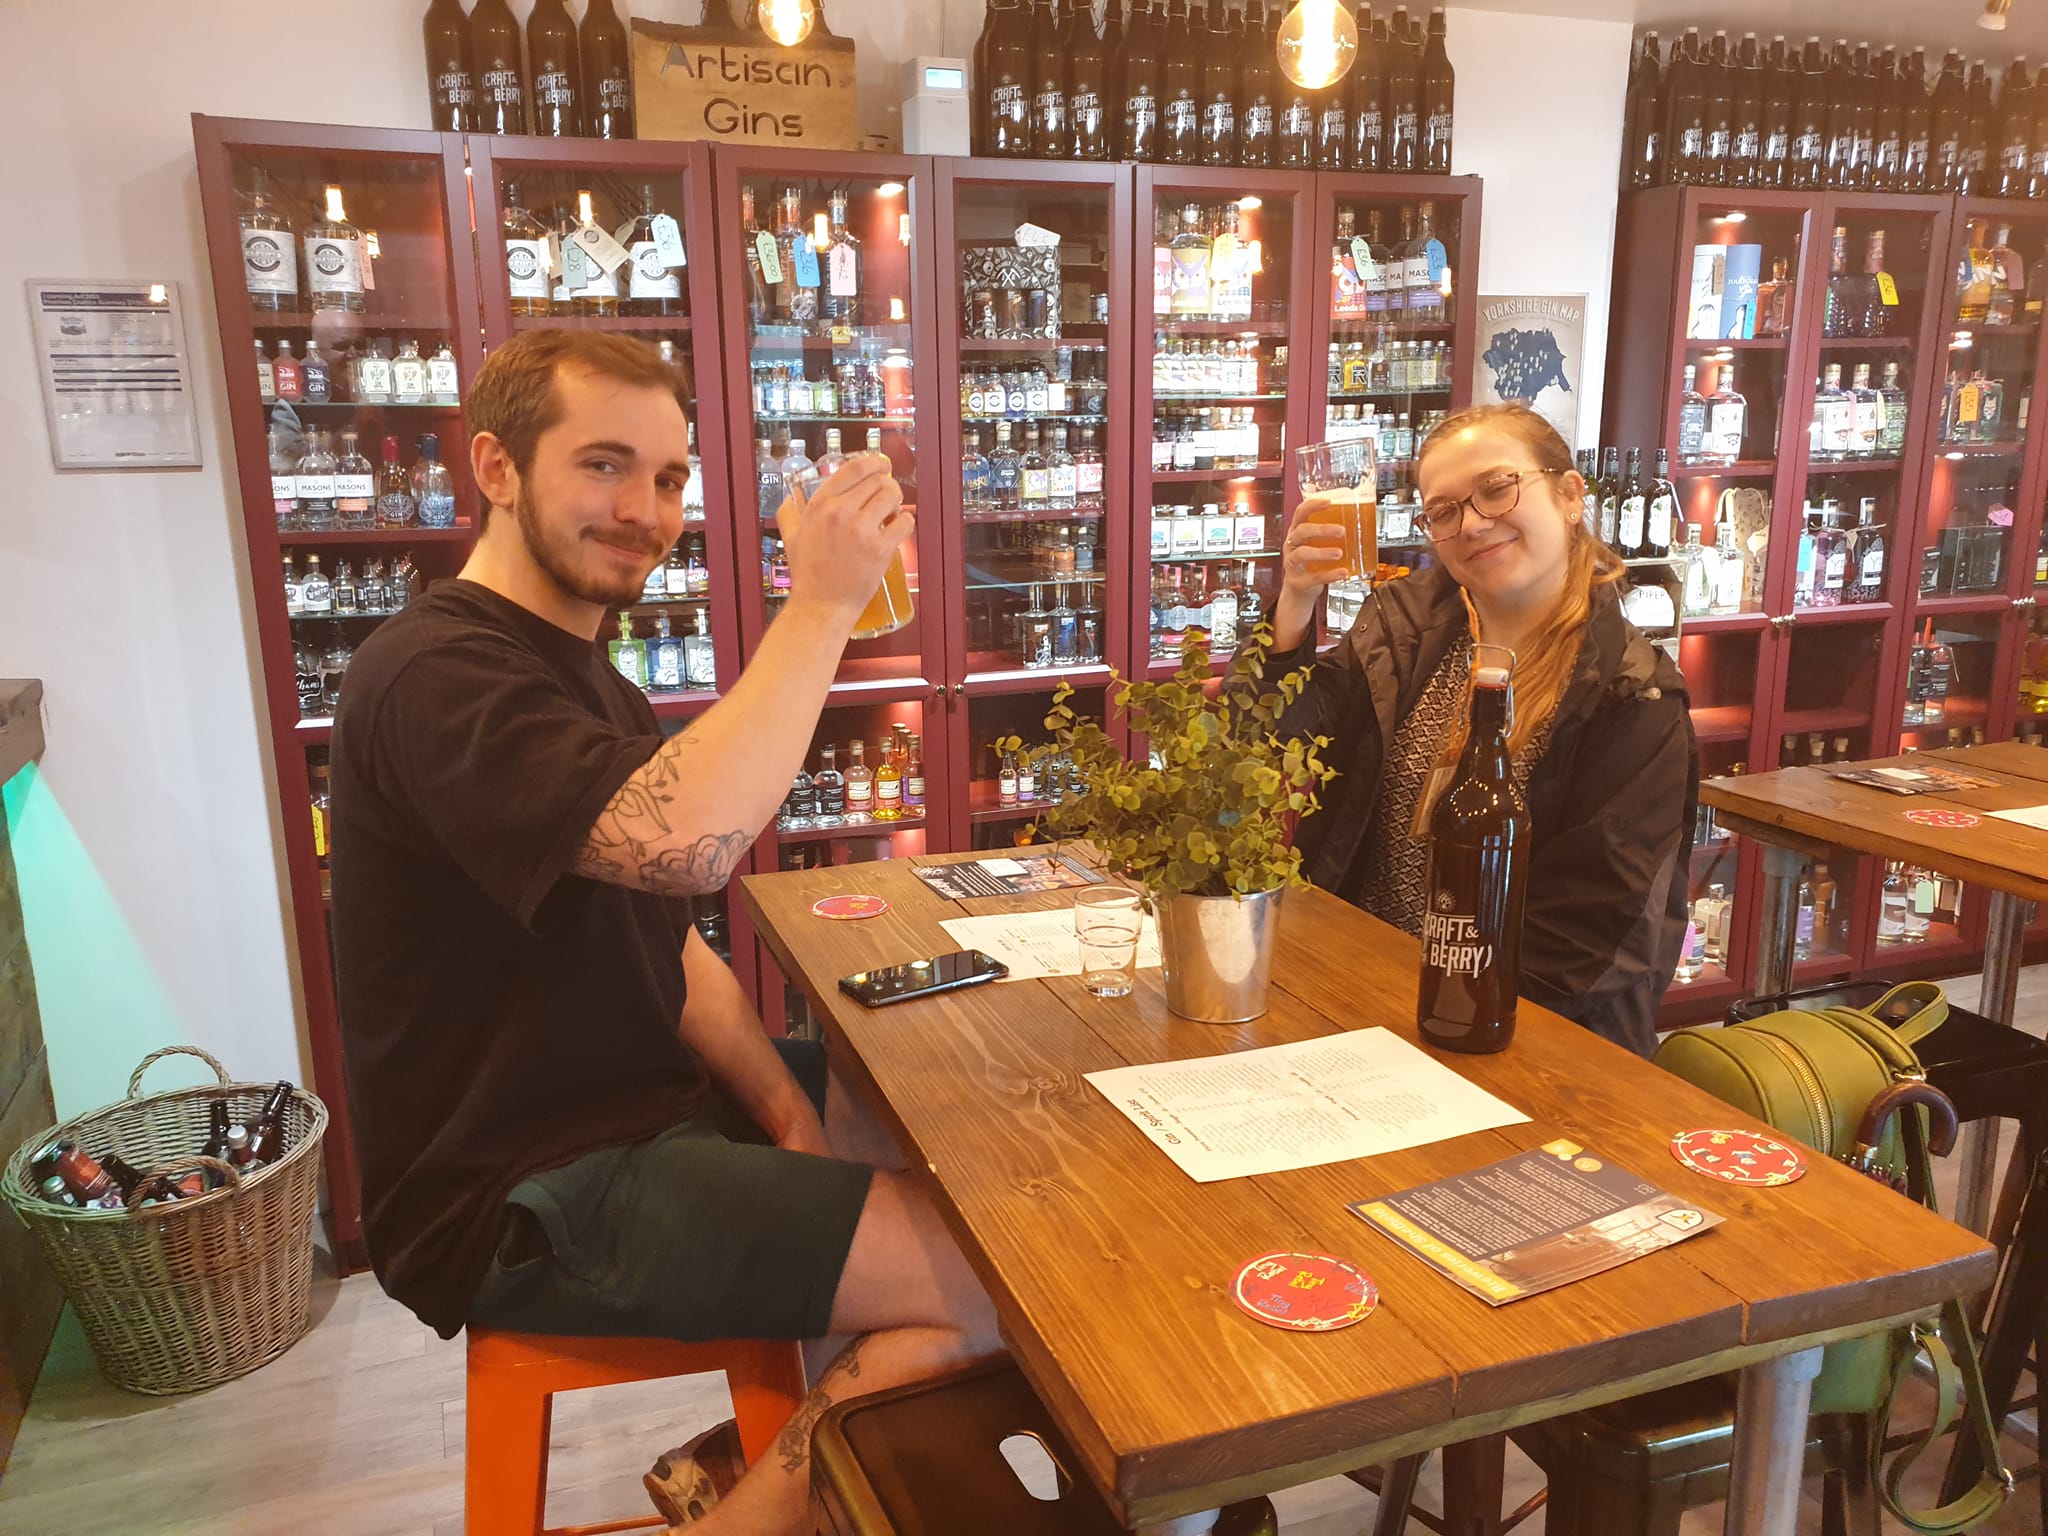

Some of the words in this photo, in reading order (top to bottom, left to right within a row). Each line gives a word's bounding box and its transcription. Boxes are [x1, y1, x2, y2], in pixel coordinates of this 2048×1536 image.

[660, 39, 831, 88] Artisan
[703, 98, 804, 137] Gins
[1483, 298, 1538, 322] YORKSHIRE
[1540, 299, 1558, 316] GIN
[1559, 303, 1580, 322] MAP
[280, 383, 296, 391] GIN
[309, 383, 325, 392] GIN
[761, 475, 779, 484] GIN
[1430, 943, 1485, 979] BERRY
[1372, 1208, 1427, 1245] Sheffield
[1427, 1243, 1441, 1253] of
[1440, 1252, 1508, 1293] Breweries
